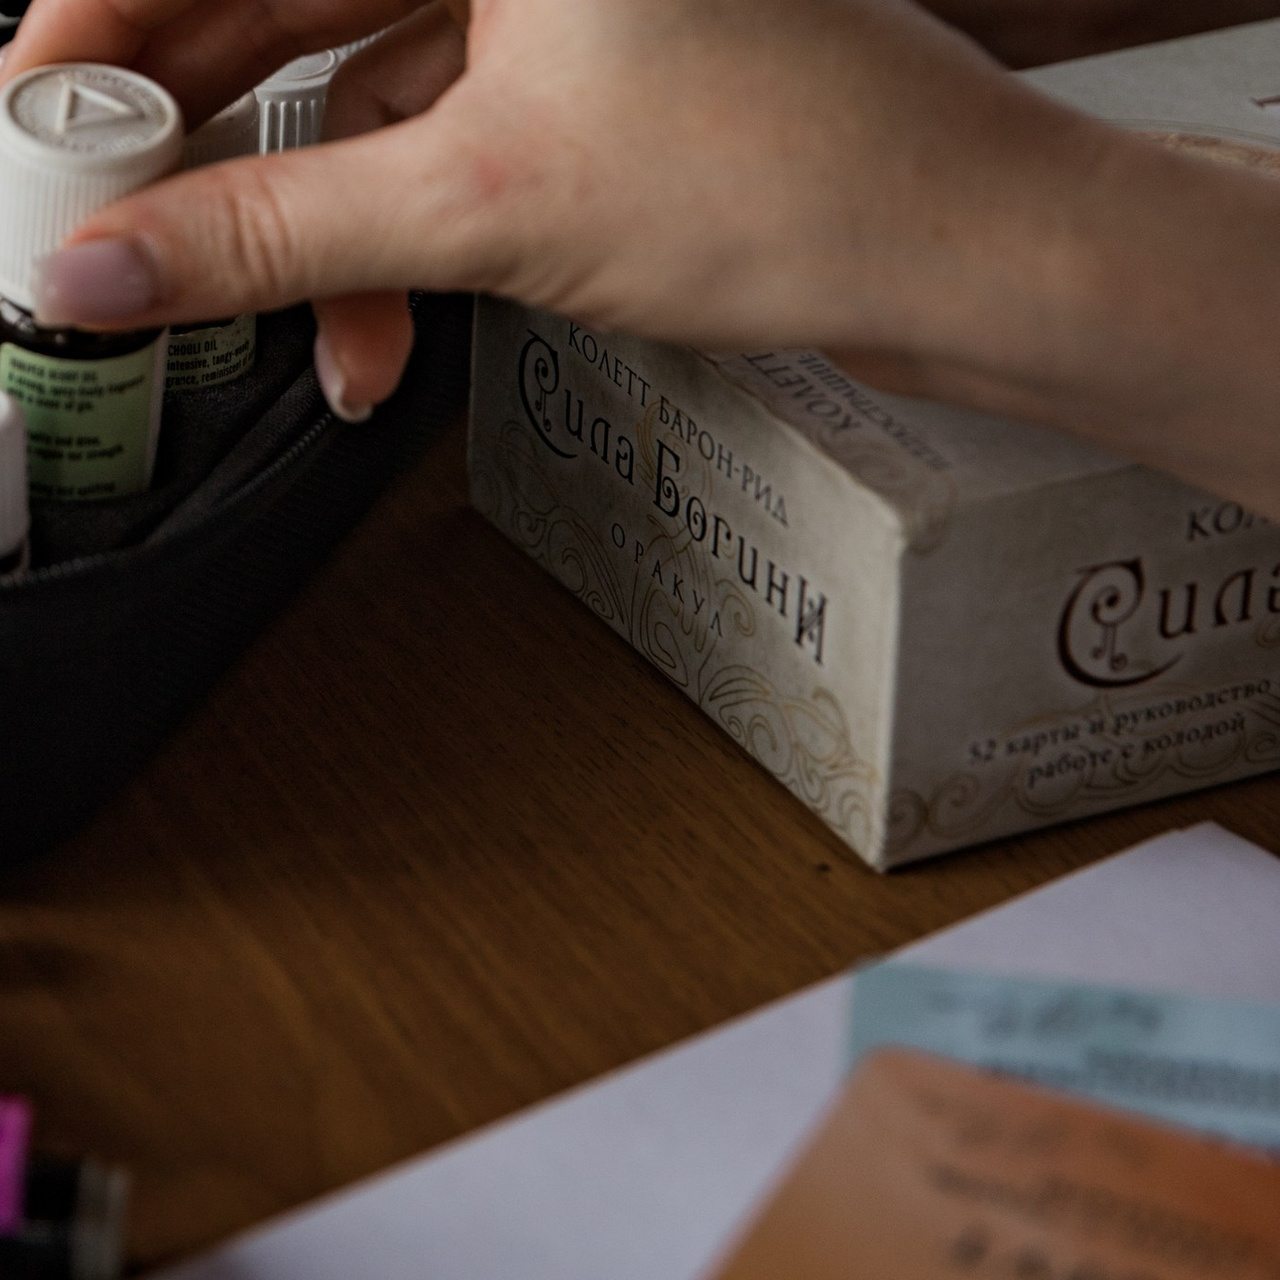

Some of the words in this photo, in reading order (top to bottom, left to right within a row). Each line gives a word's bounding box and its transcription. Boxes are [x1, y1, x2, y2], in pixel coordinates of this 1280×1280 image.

[204, 340, 217, 352] OIL
[519, 328, 636, 486] Сила
[568, 322, 651, 408] КОЛЕТТ
[659, 395, 790, 528] БАРОН-РИД
[611, 522, 724, 637] ОРАКУЛ
[1006, 726, 1079, 757] карты
[1088, 718, 1105, 735] и
[1112, 679, 1270, 736] руководство
[1028, 748, 1112, 789] работе
[1121, 745, 1134, 759] с
[1143, 712, 1245, 754] колодой
